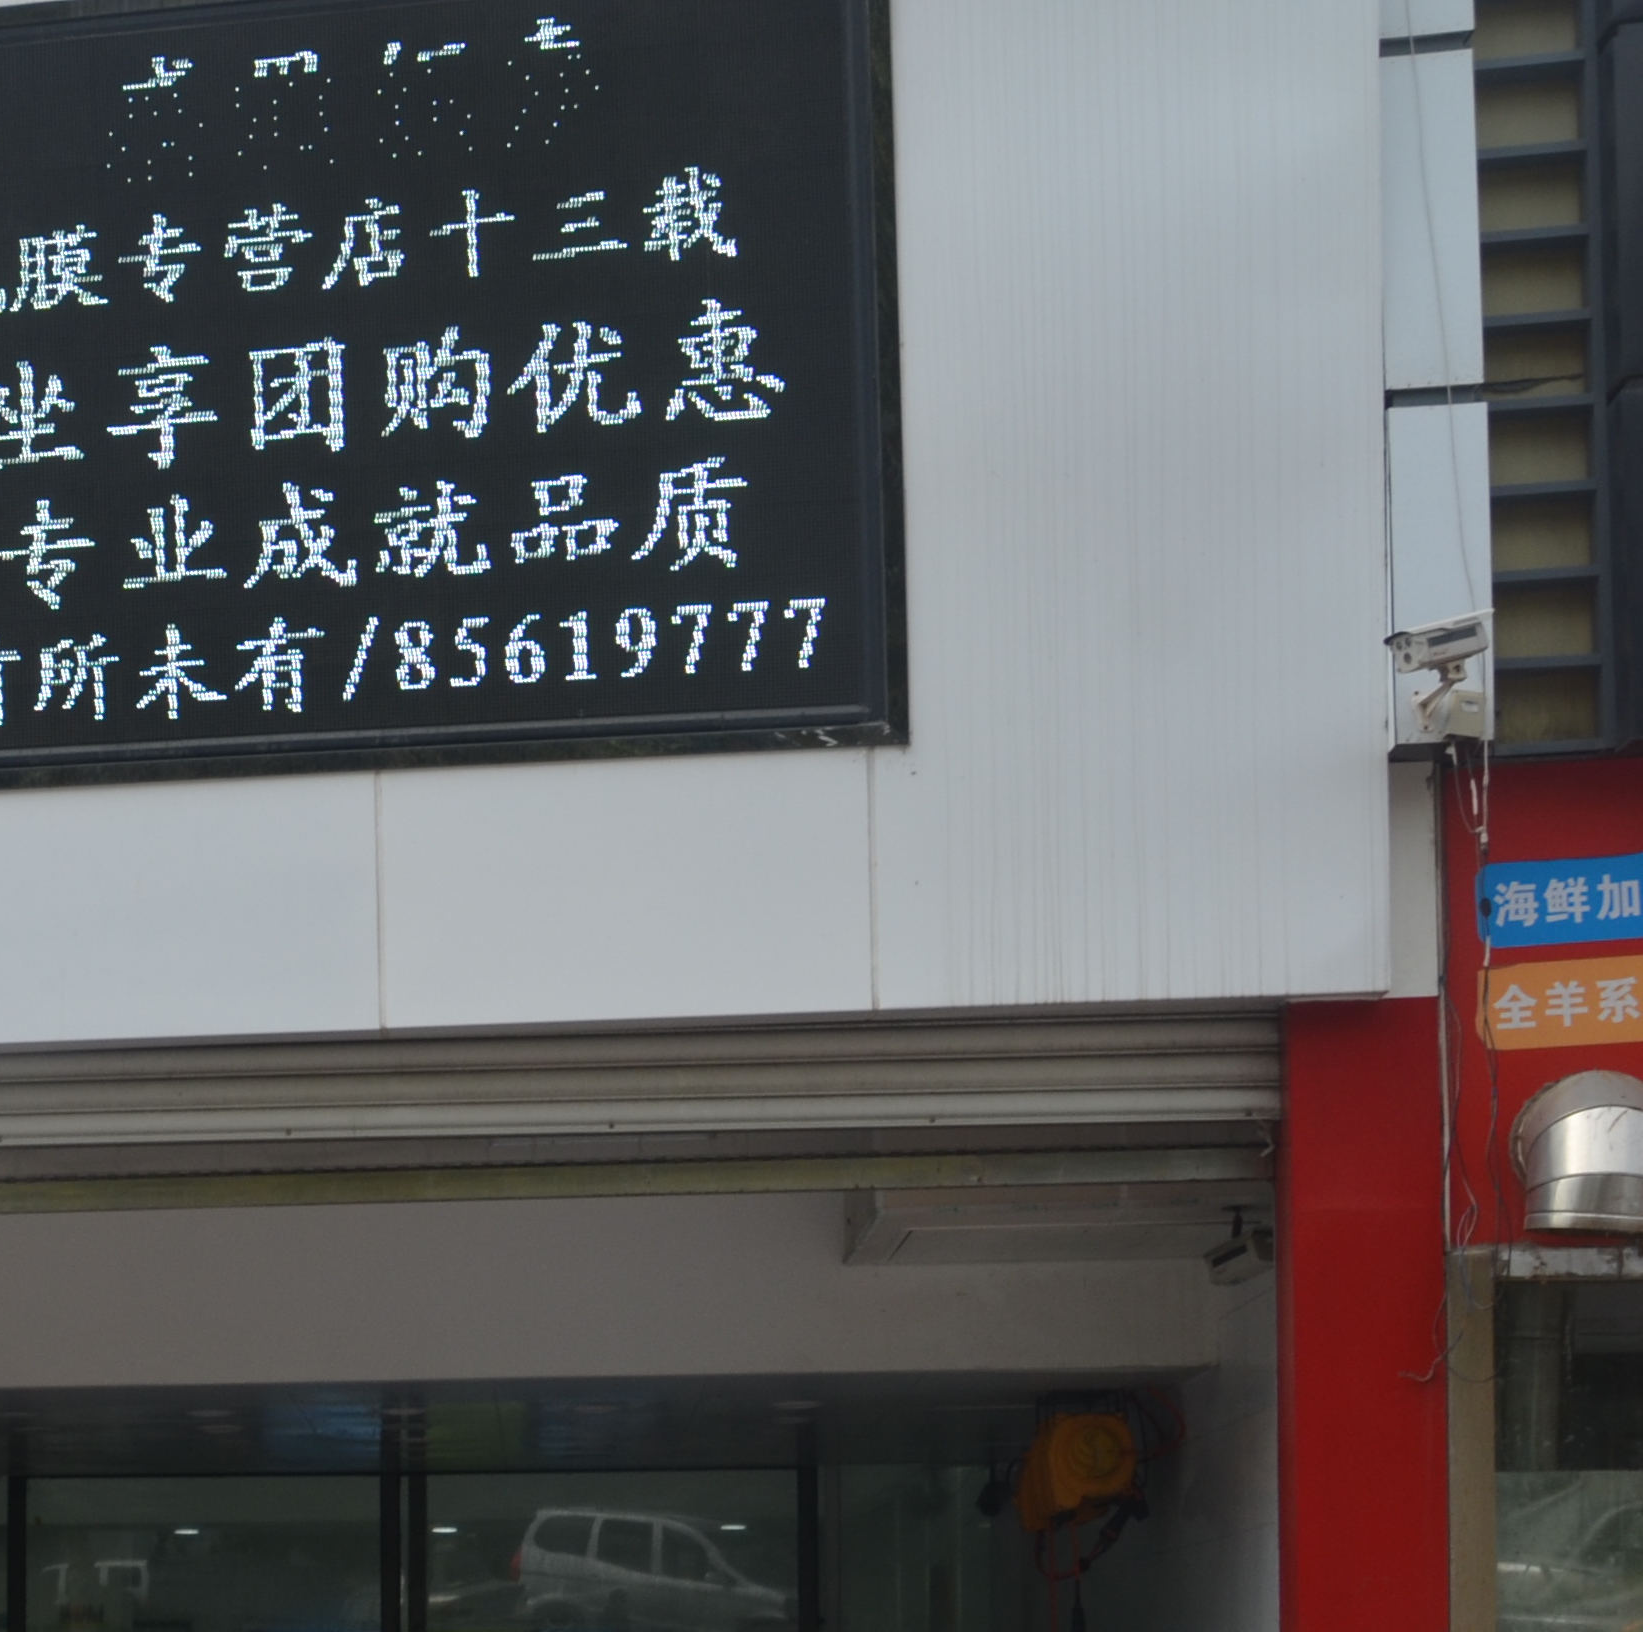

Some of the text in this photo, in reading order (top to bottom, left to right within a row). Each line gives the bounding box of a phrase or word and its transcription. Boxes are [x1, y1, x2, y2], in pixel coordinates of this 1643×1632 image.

[1493, 873, 1642, 927] 海鲜加
[1493, 976, 1641, 1030] 全羊系
